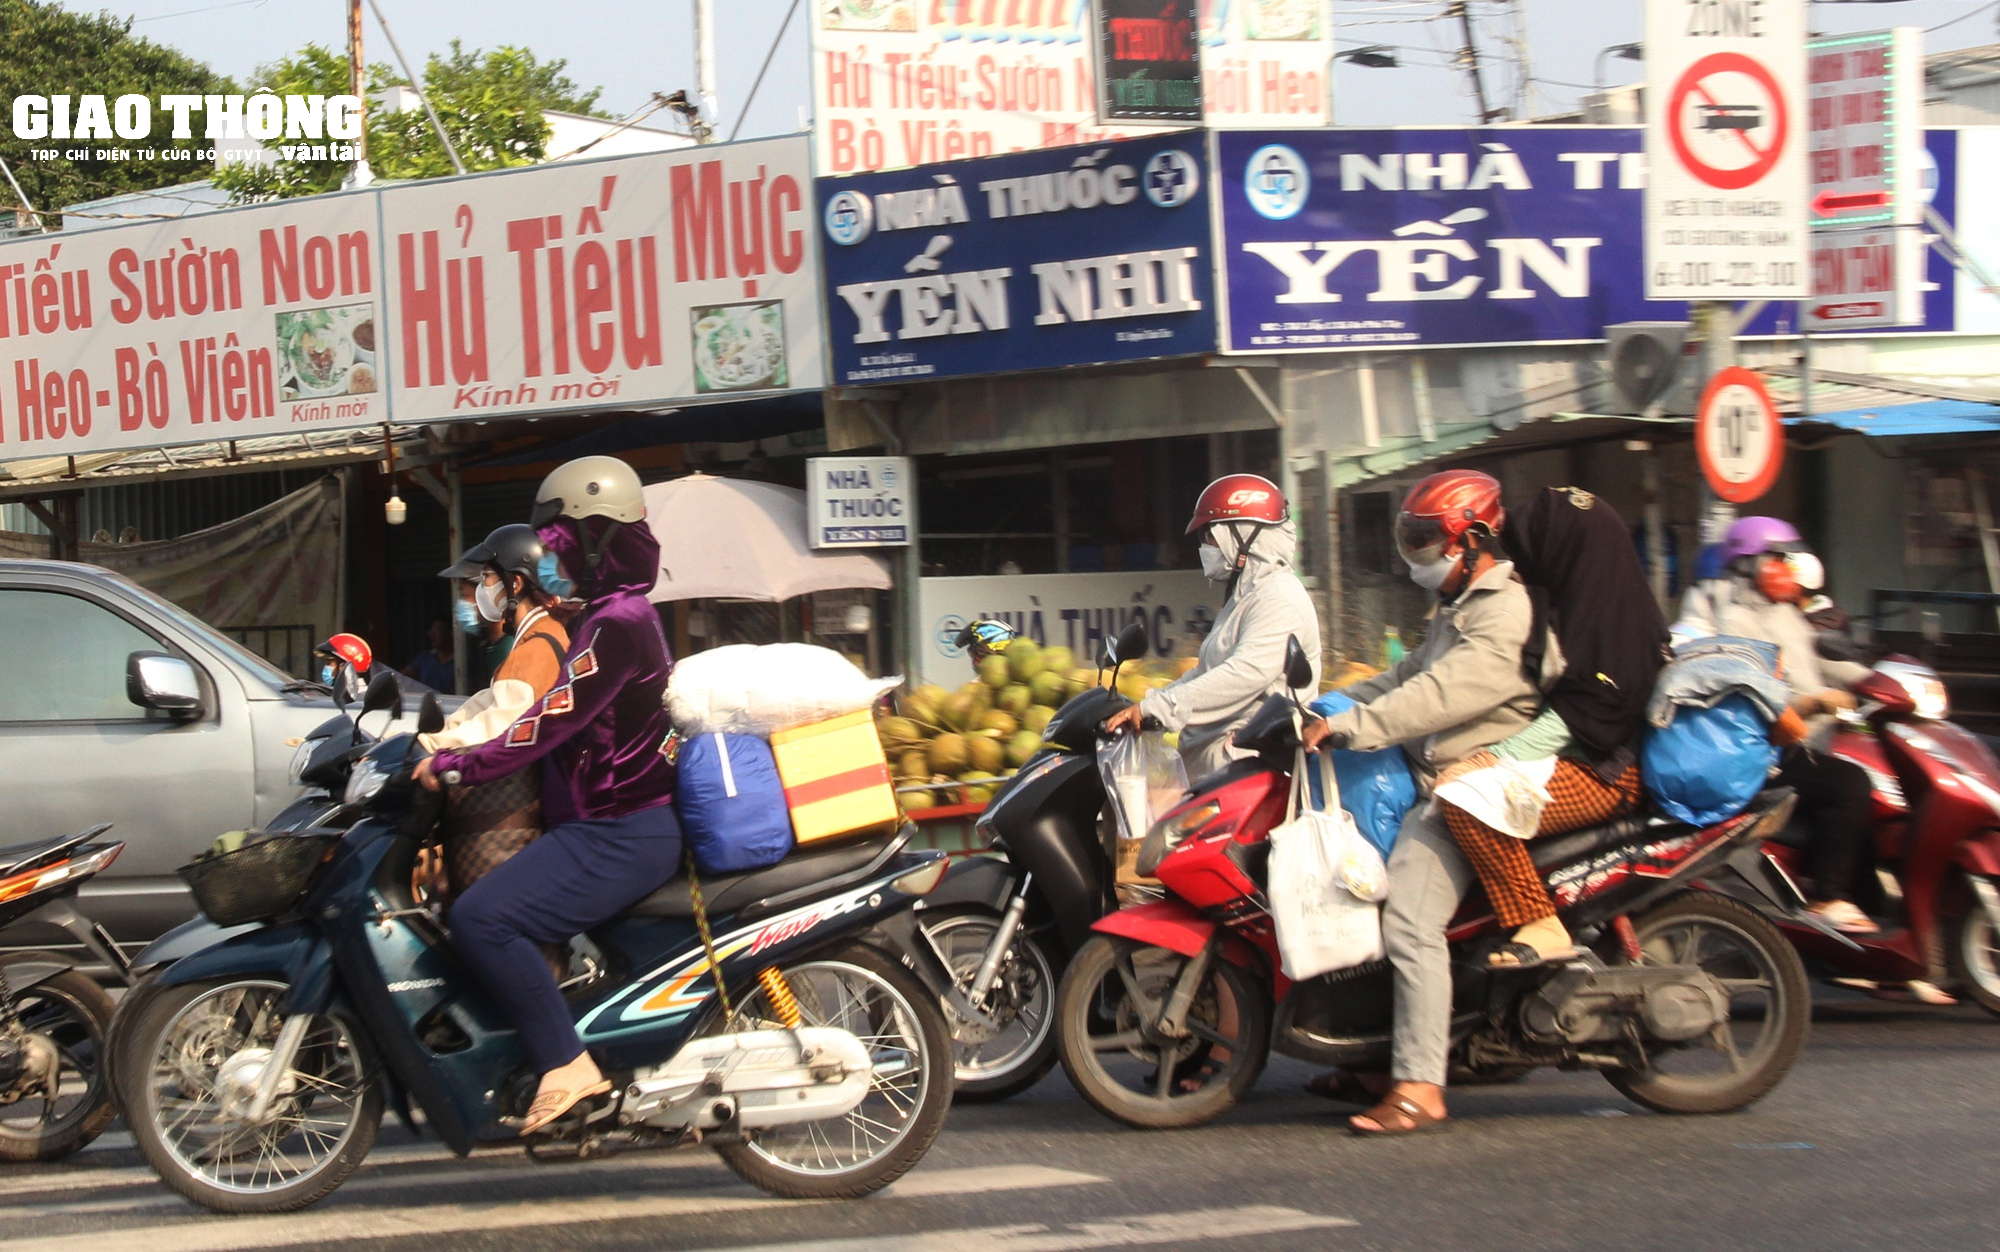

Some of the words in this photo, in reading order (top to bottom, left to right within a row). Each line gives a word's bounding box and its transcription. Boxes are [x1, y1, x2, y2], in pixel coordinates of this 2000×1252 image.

[826, 48, 870, 109] Hủ
[975, 53, 1064, 113] Sườn
[1261, 60, 1321, 113] Heo
[831, 118, 883, 172] Bò
[1339, 143, 1532, 191] NHÀ
[874, 174, 970, 233] NHÀ
[979, 149, 1140, 219] THUỐC
[670, 160, 804, 298] Mực
[1242, 207, 1602, 303] YẾN
[108, 238, 242, 325] Sườn
[260, 225, 371, 306] Non
[399, 204, 488, 389] Hủ
[507, 176, 663, 378] Tiếu
[837, 235, 1012, 344] YẾN
[1031, 247, 1202, 326] NHI
[180, 332, 274, 424] Viên
[453, 383, 536, 409] Kính
[550, 375, 620, 401] mời
[291, 401, 329, 423] Kính
[336, 399, 368, 418] mời
[826, 465, 872, 489] NHÀ
[826, 490, 902, 518] THUỐC
[1227, 490, 1270, 507] GP
[750, 912, 826, 956] Wave
